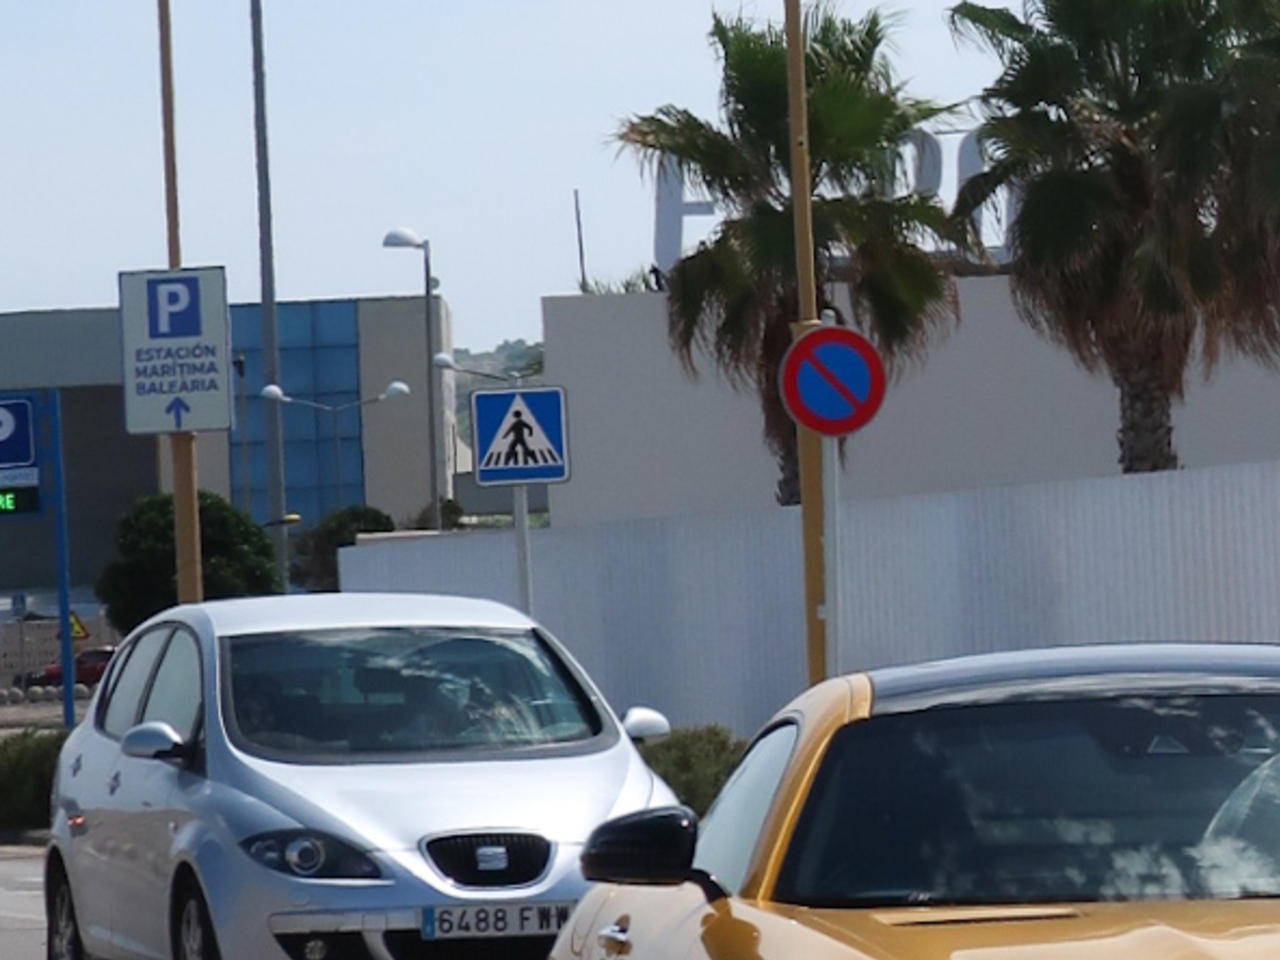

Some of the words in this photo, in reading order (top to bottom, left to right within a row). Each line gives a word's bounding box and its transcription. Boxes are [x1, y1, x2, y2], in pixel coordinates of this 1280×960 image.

[156, 283, 190, 334] P
[135, 344, 216, 362] ESTACIÓN
[438, 907, 508, 934] 6488
